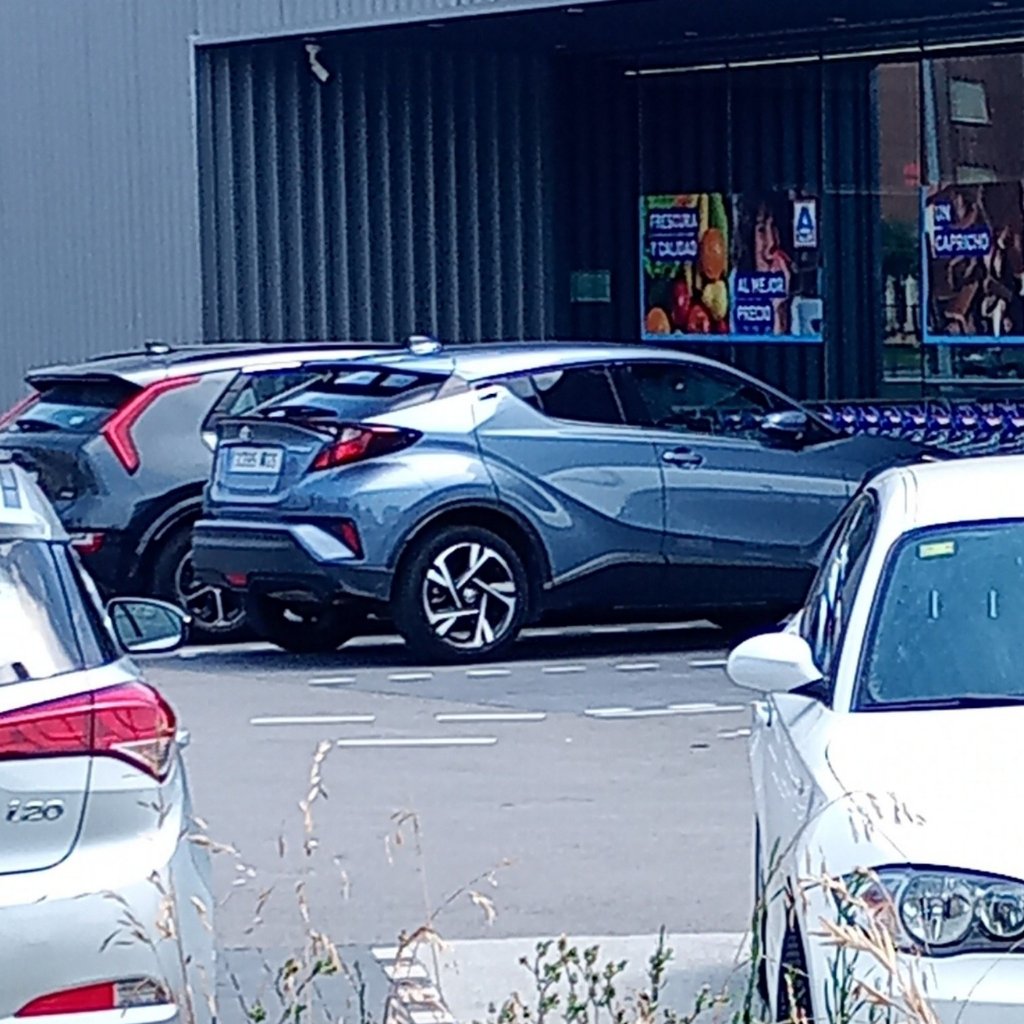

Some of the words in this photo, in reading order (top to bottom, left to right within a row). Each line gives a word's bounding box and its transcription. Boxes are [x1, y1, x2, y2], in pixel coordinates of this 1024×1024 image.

[935, 231, 990, 252] CAPRICHO
[737, 277, 749, 294] AL
[750, 276, 785, 294] MEJOR
[737, 304, 771, 322] PRECIO
[5, 799, 66, 823] i20
